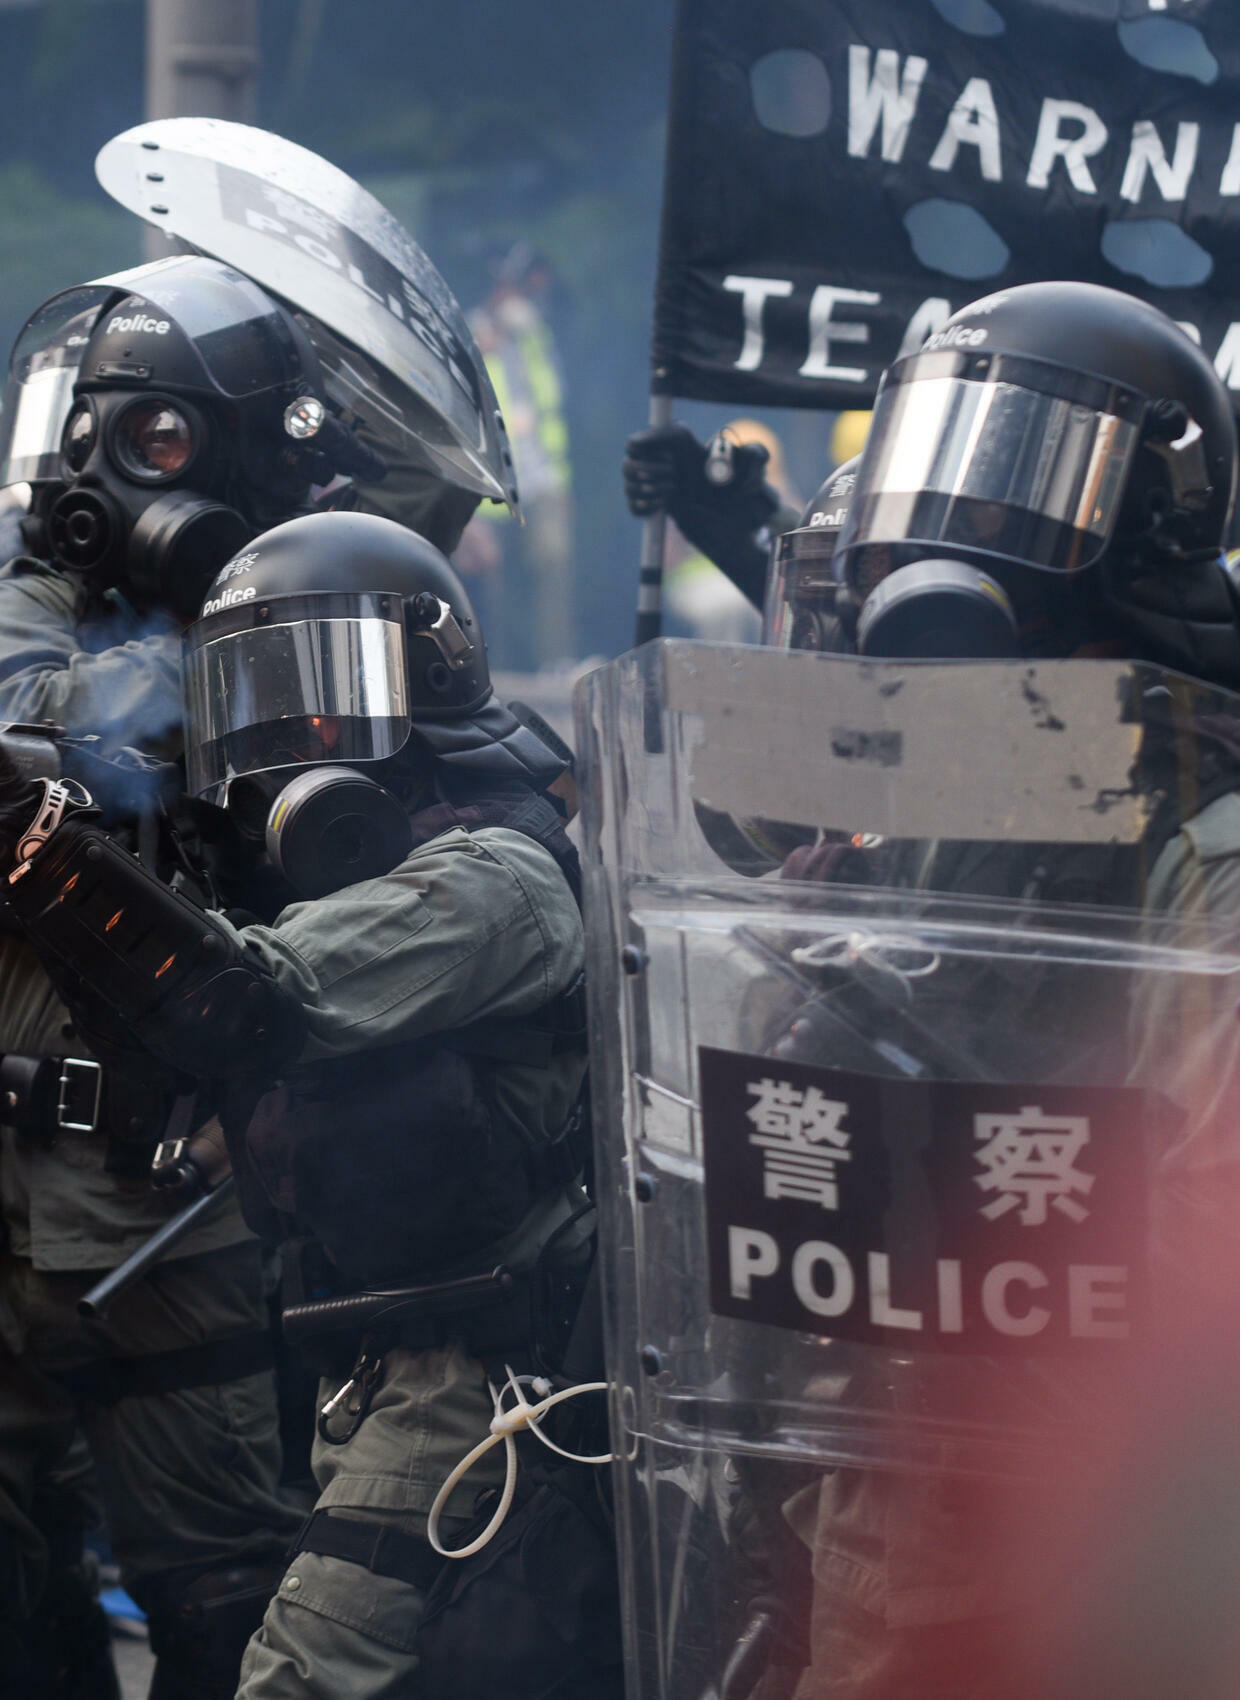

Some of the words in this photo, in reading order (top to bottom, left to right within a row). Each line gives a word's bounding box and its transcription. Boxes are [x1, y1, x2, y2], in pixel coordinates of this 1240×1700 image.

[106, 314, 171, 335] Police
[723, 275, 952, 383] TEA
[920, 324, 988, 353] Police
[810, 508, 848, 527] Poli
[202, 587, 257, 617] Police
[746, 1078, 1096, 1226] 警察
[728, 1225, 1131, 1339] POLICE
